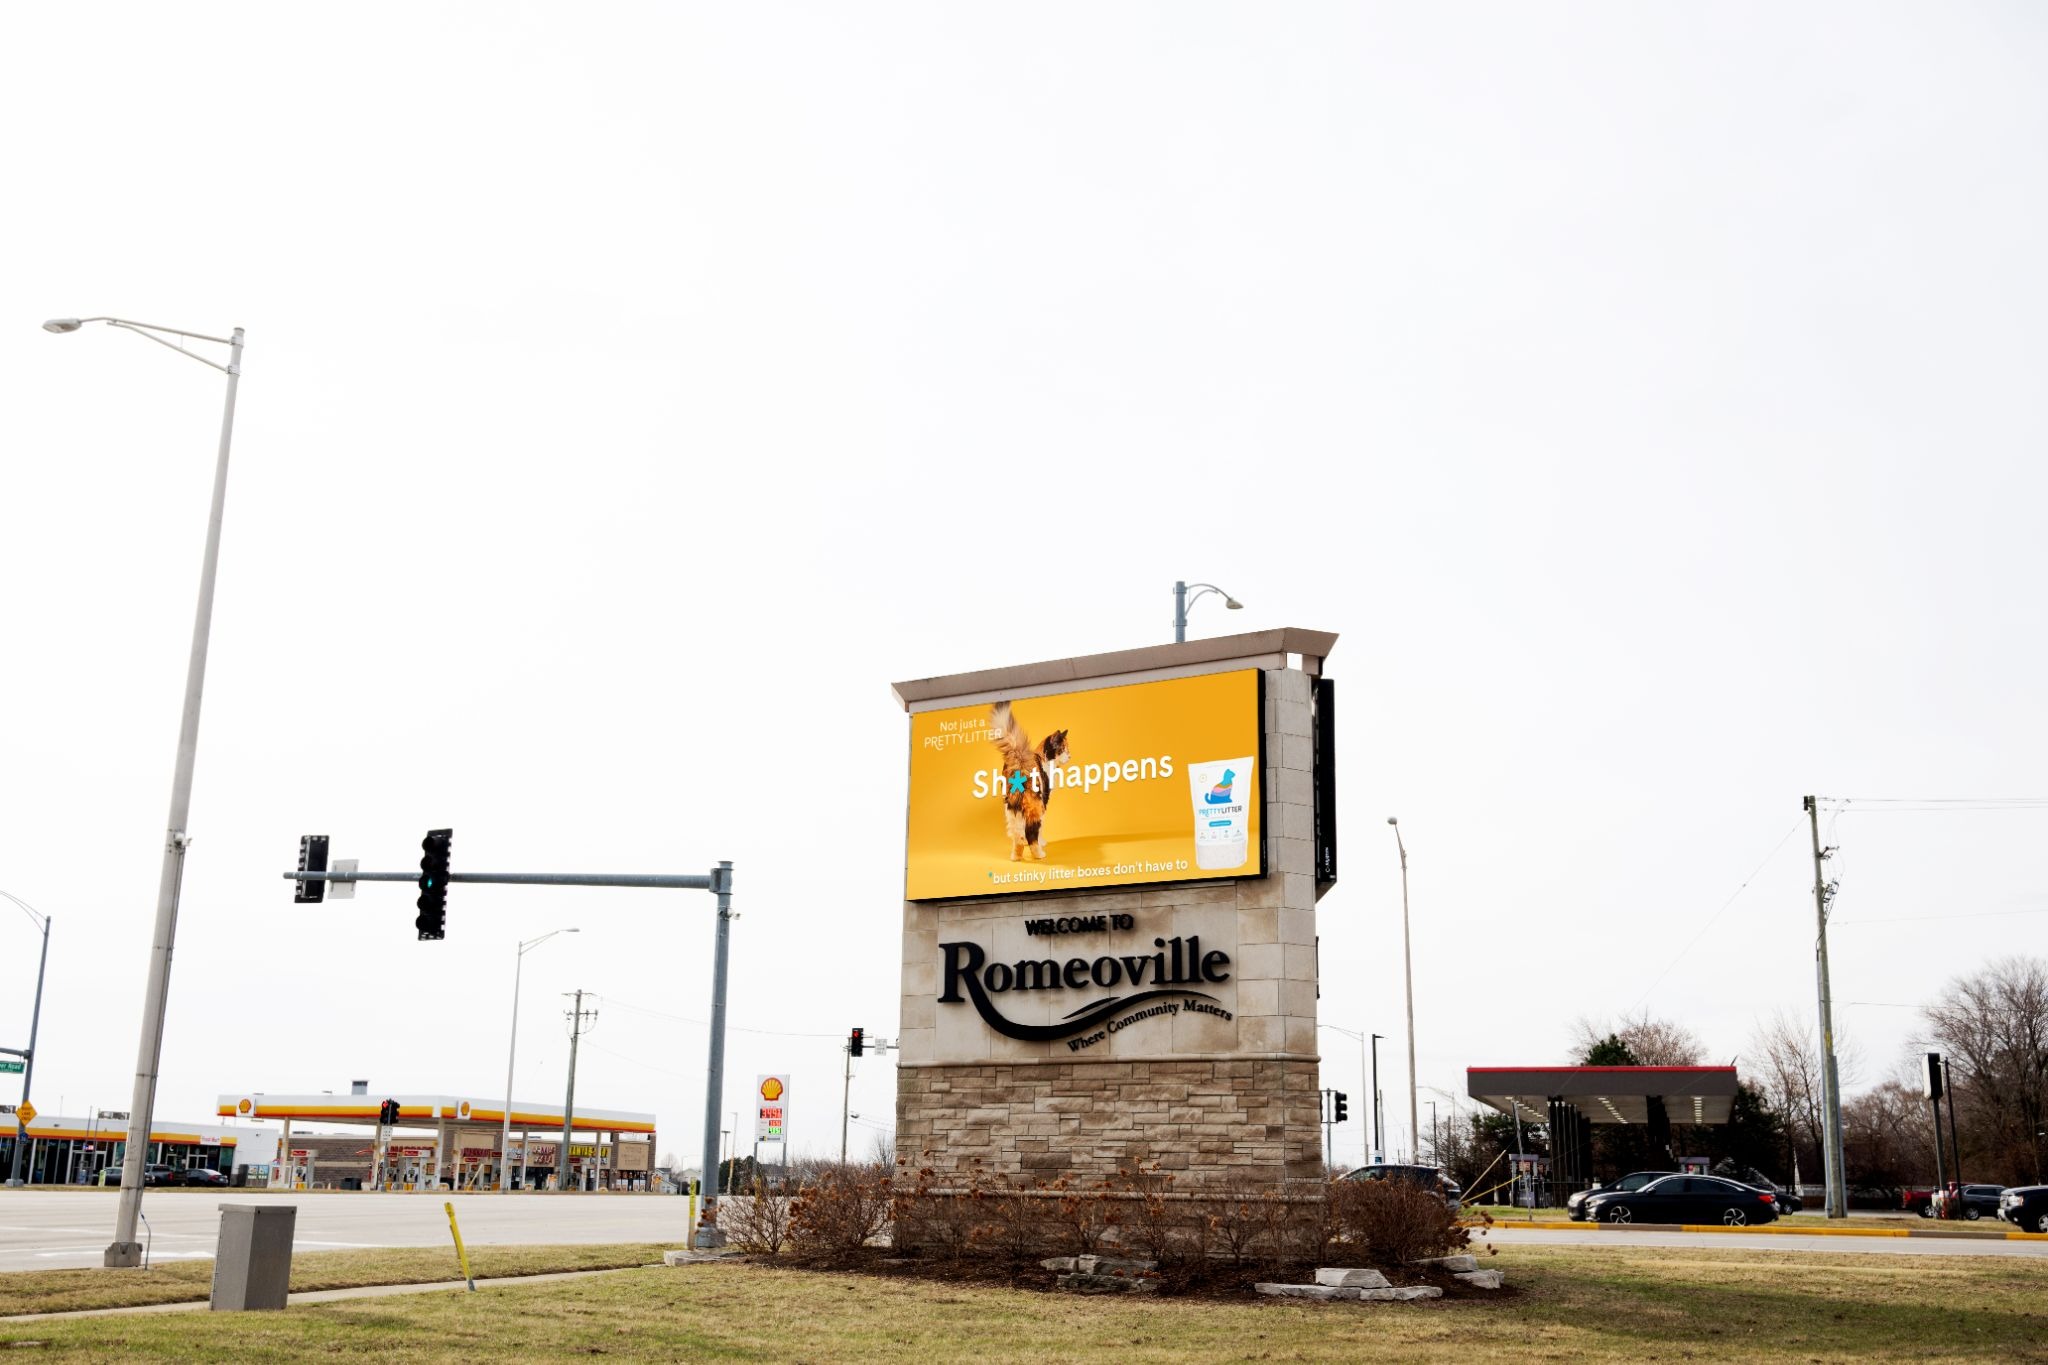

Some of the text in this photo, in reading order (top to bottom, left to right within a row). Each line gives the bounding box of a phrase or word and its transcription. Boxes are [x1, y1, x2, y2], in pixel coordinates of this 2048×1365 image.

[940, 719, 986, 733] Not just a
[924, 728, 1003, 751] PRETTYLITTER
[1049, 755, 1174, 793] happens
[1198, 805, 1243, 818] PRETTYLITTER
[1013, 867, 1046, 883] stinky
[1049, 867, 1075, 880] litter
[1077, 864, 1111, 877] boxes
[1113, 861, 1143, 874] don't
[1145, 860, 1173, 872] have
[1175, 859, 1188, 870] to
[1025, 913, 1134, 936] WELCOME TO
[937, 935, 1230, 1020] Romeoville
[1067, 999, 1233, 1052] Where Community Matters
